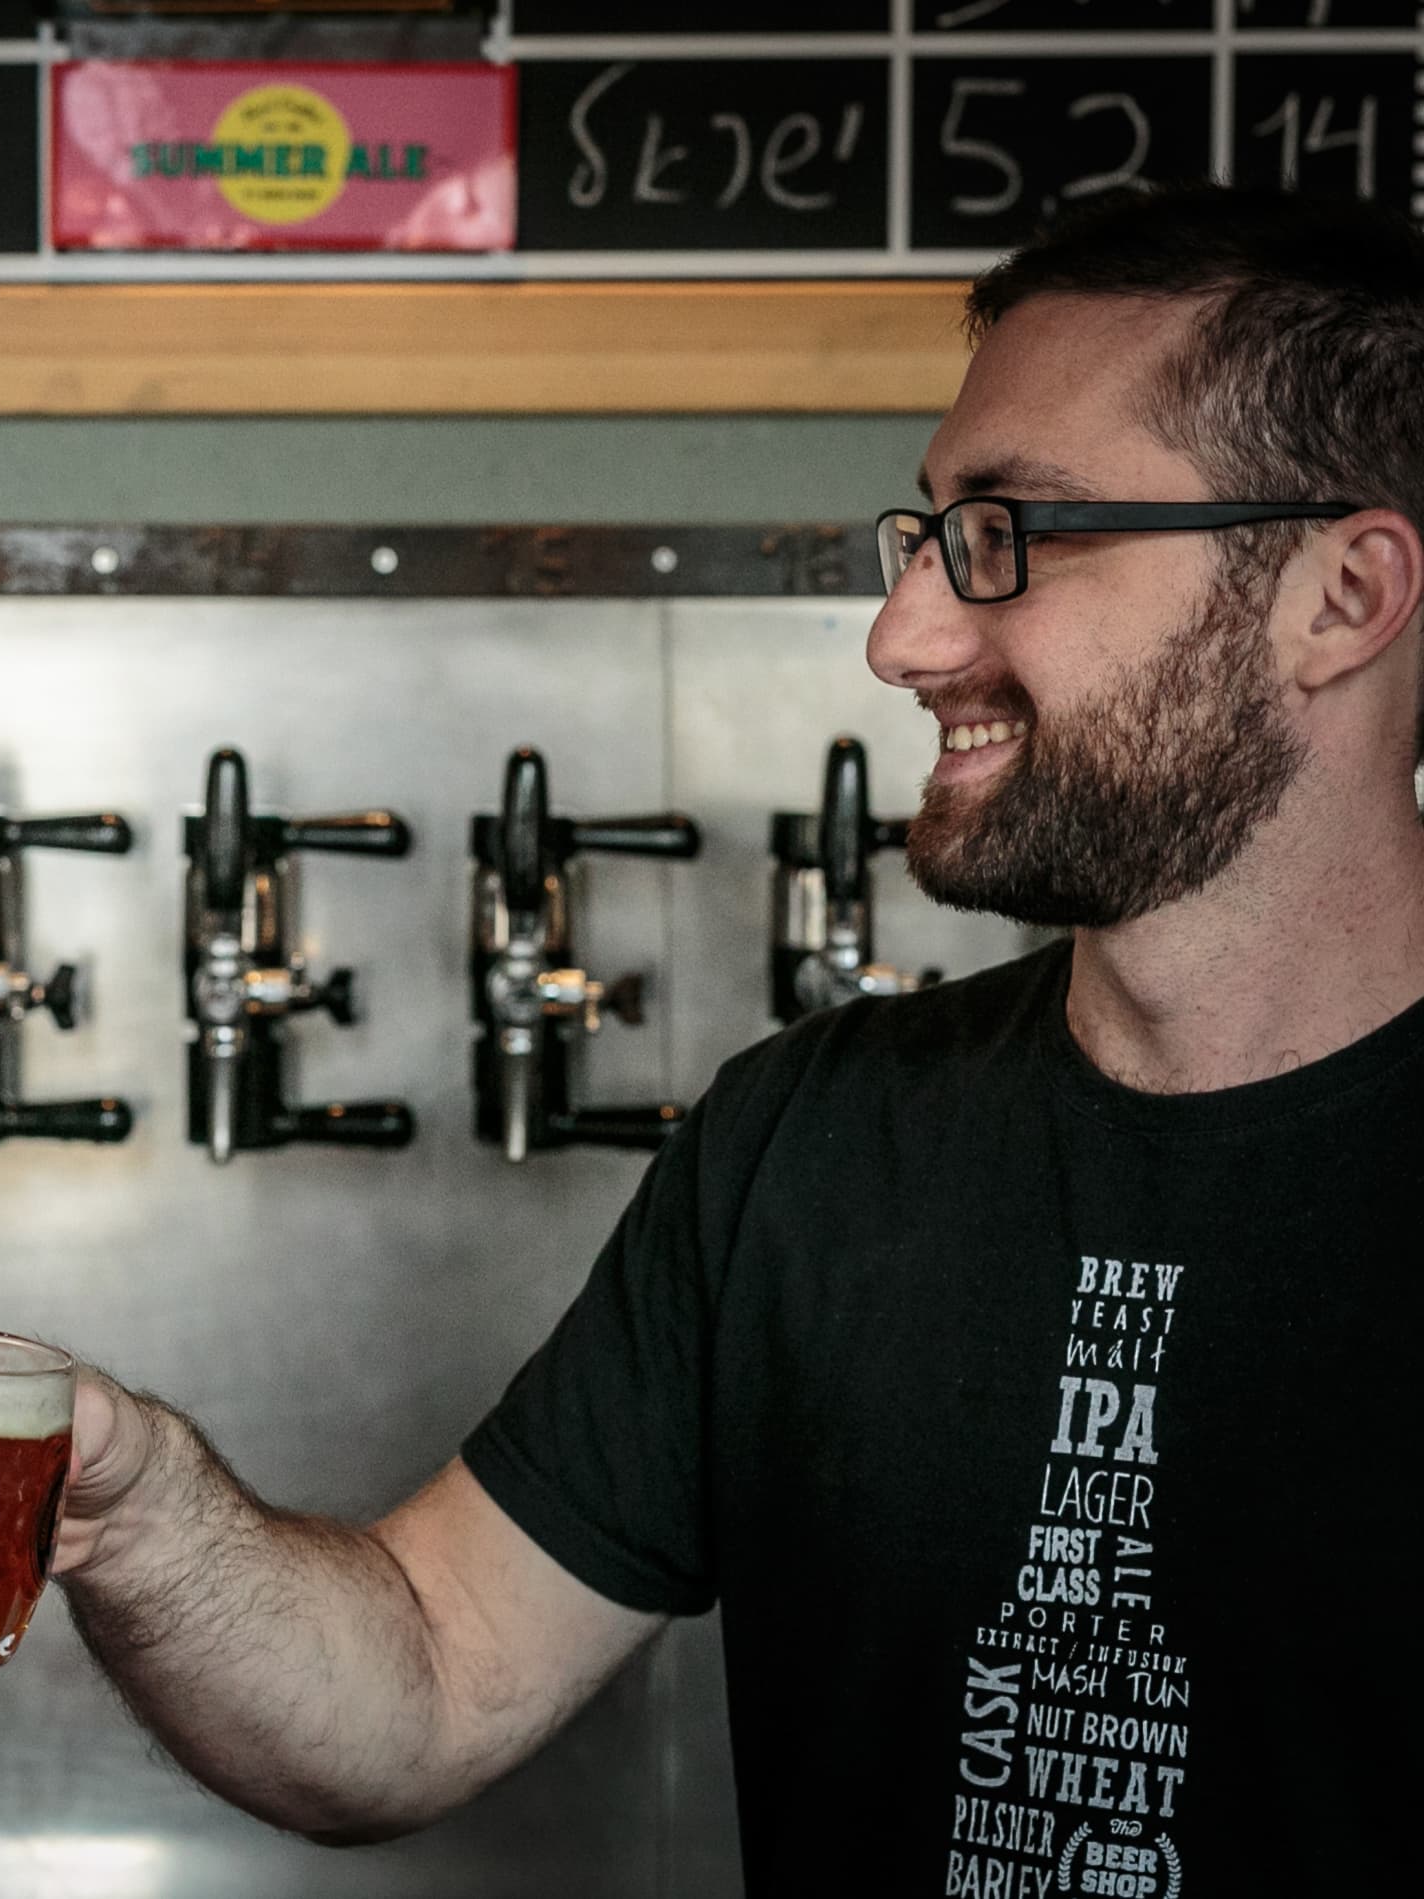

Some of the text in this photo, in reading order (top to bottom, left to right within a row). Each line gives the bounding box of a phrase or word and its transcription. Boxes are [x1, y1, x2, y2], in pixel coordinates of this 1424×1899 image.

[131, 140, 428, 181] SUMMER ALE
[940, 77, 1154, 215] 5.2
[1252, 92, 1377, 199] 14
[1076, 1256, 1184, 1301] BREW
[1071, 1300, 1174, 1334] YEAST
[1066, 1333, 1166, 1373] malt
[1050, 1375, 1159, 1464] IPA
[1040, 1463, 1154, 1528] LAGER
[1029, 1525, 1102, 1564] FIRST
[1018, 1565, 1100, 1606] CLASS
[1112, 1536, 1153, 1609] ALE
[1001, 1601, 1165, 1645] PORTER
[977, 1627, 1059, 1656] EXTRACT
[1088, 1644, 1187, 1675] INFUSION
[1032, 1658, 1189, 1708] MASH TUN
[959, 1657, 1022, 1787] CASK
[1027, 1703, 1189, 1758] NUT BROWN
[1025, 1746, 1184, 1817] WHEAT
[952, 1794, 1055, 1857] PILSNER
[1110, 1819, 1143, 1837] The
[1085, 1841, 1158, 1873] BEER
[1080, 1869, 1157, 1899] SHOP
